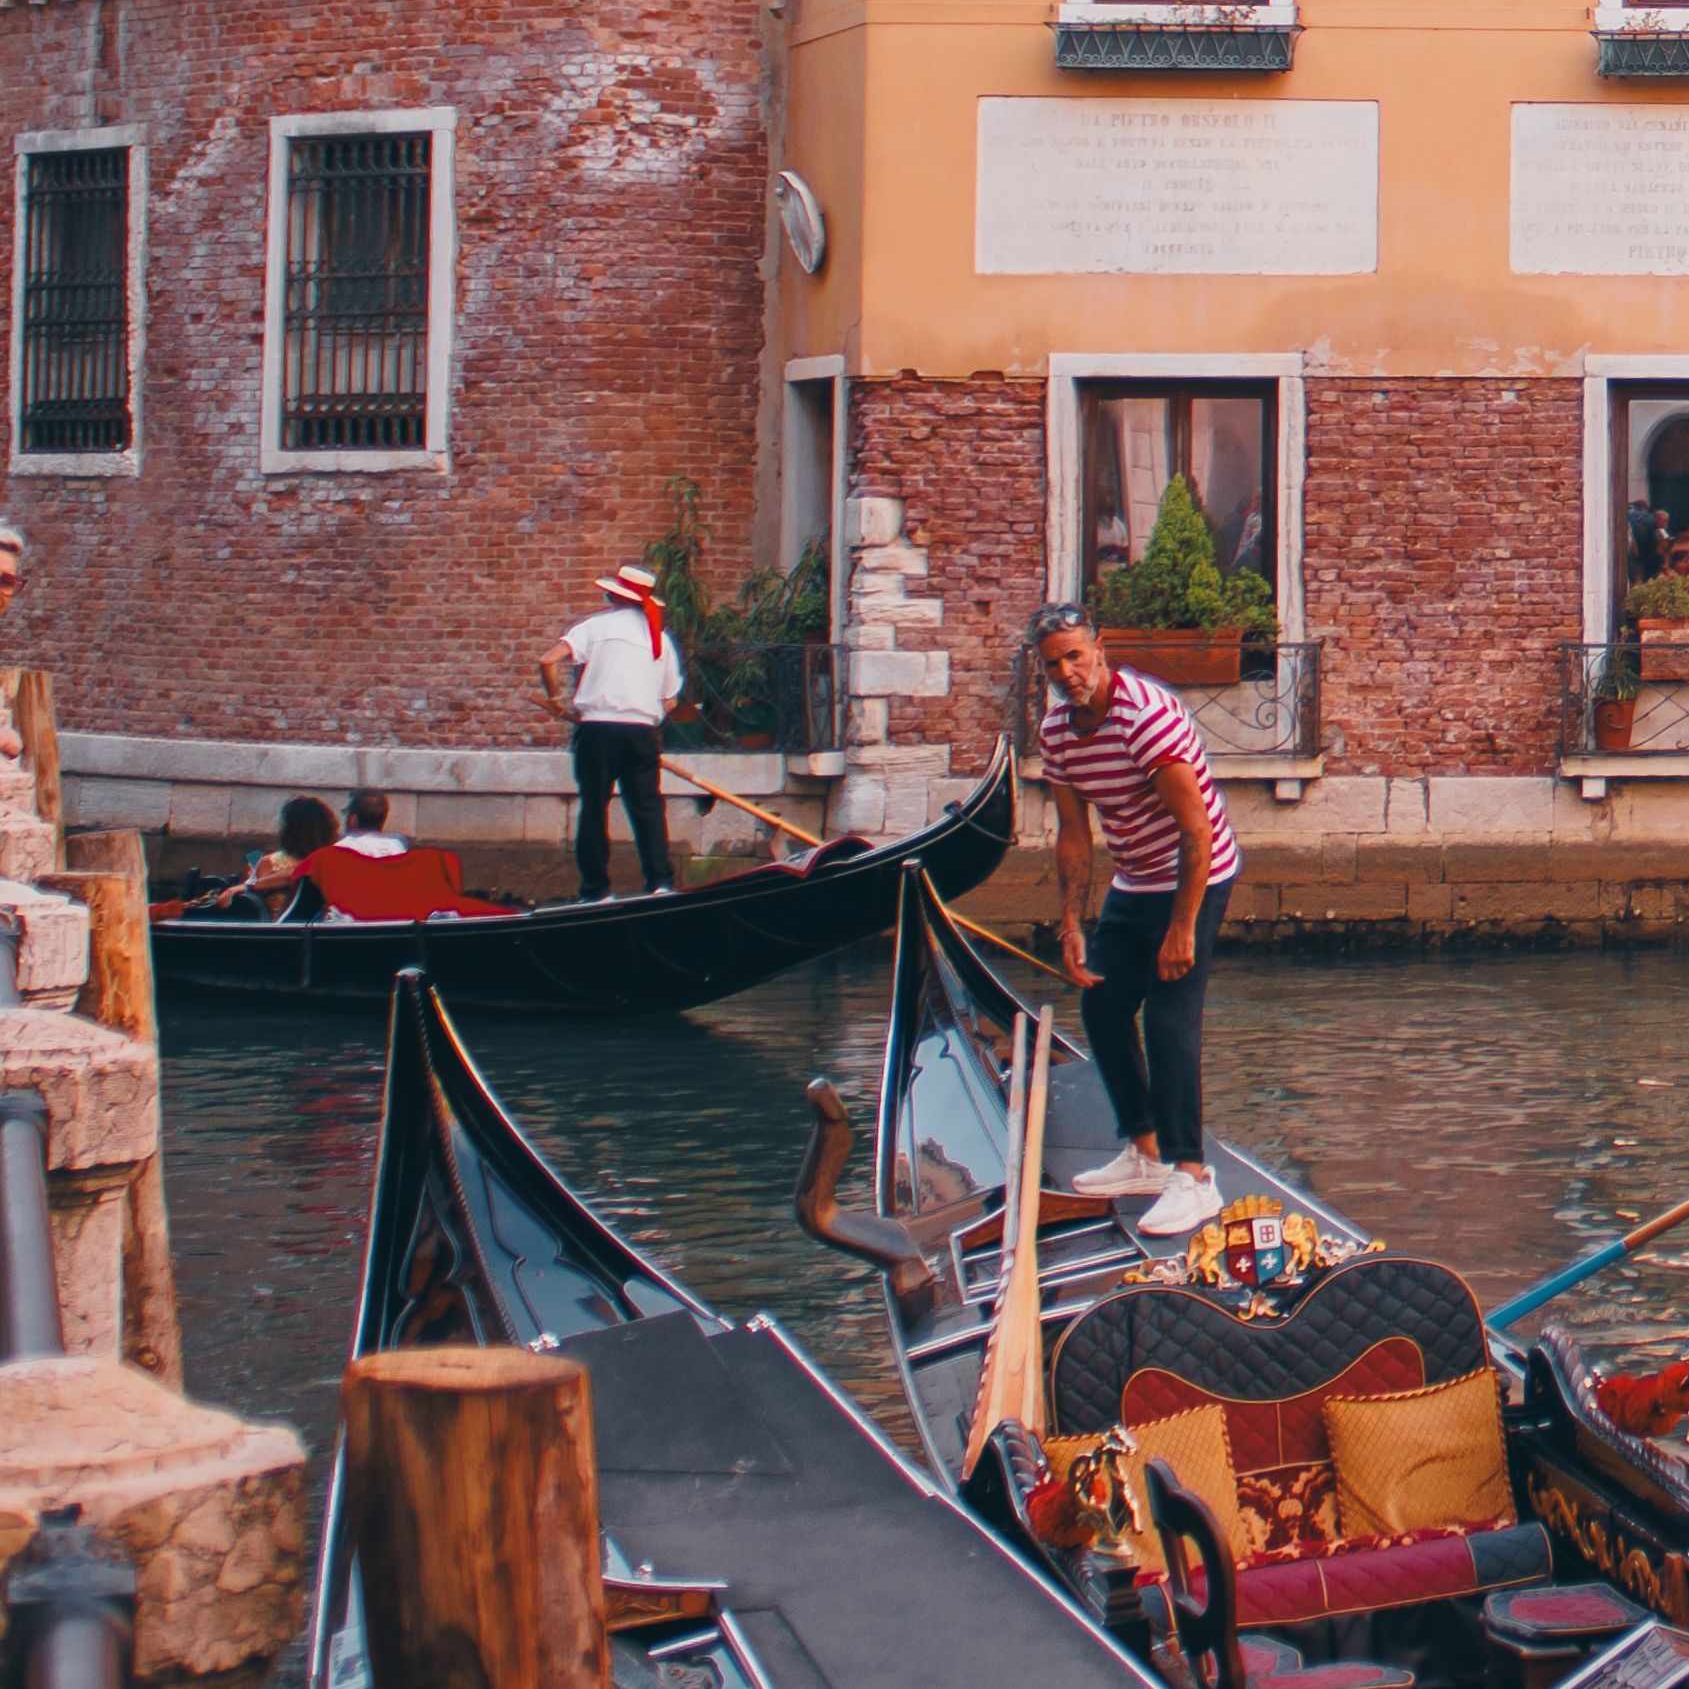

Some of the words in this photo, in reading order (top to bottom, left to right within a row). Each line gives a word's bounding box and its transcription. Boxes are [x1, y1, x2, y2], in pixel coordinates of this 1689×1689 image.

[1110, 113, 1171, 128] PIETRO
[1180, 114, 1255, 129] ORSEOLO
[1627, 244, 1688, 259] PIETRO
